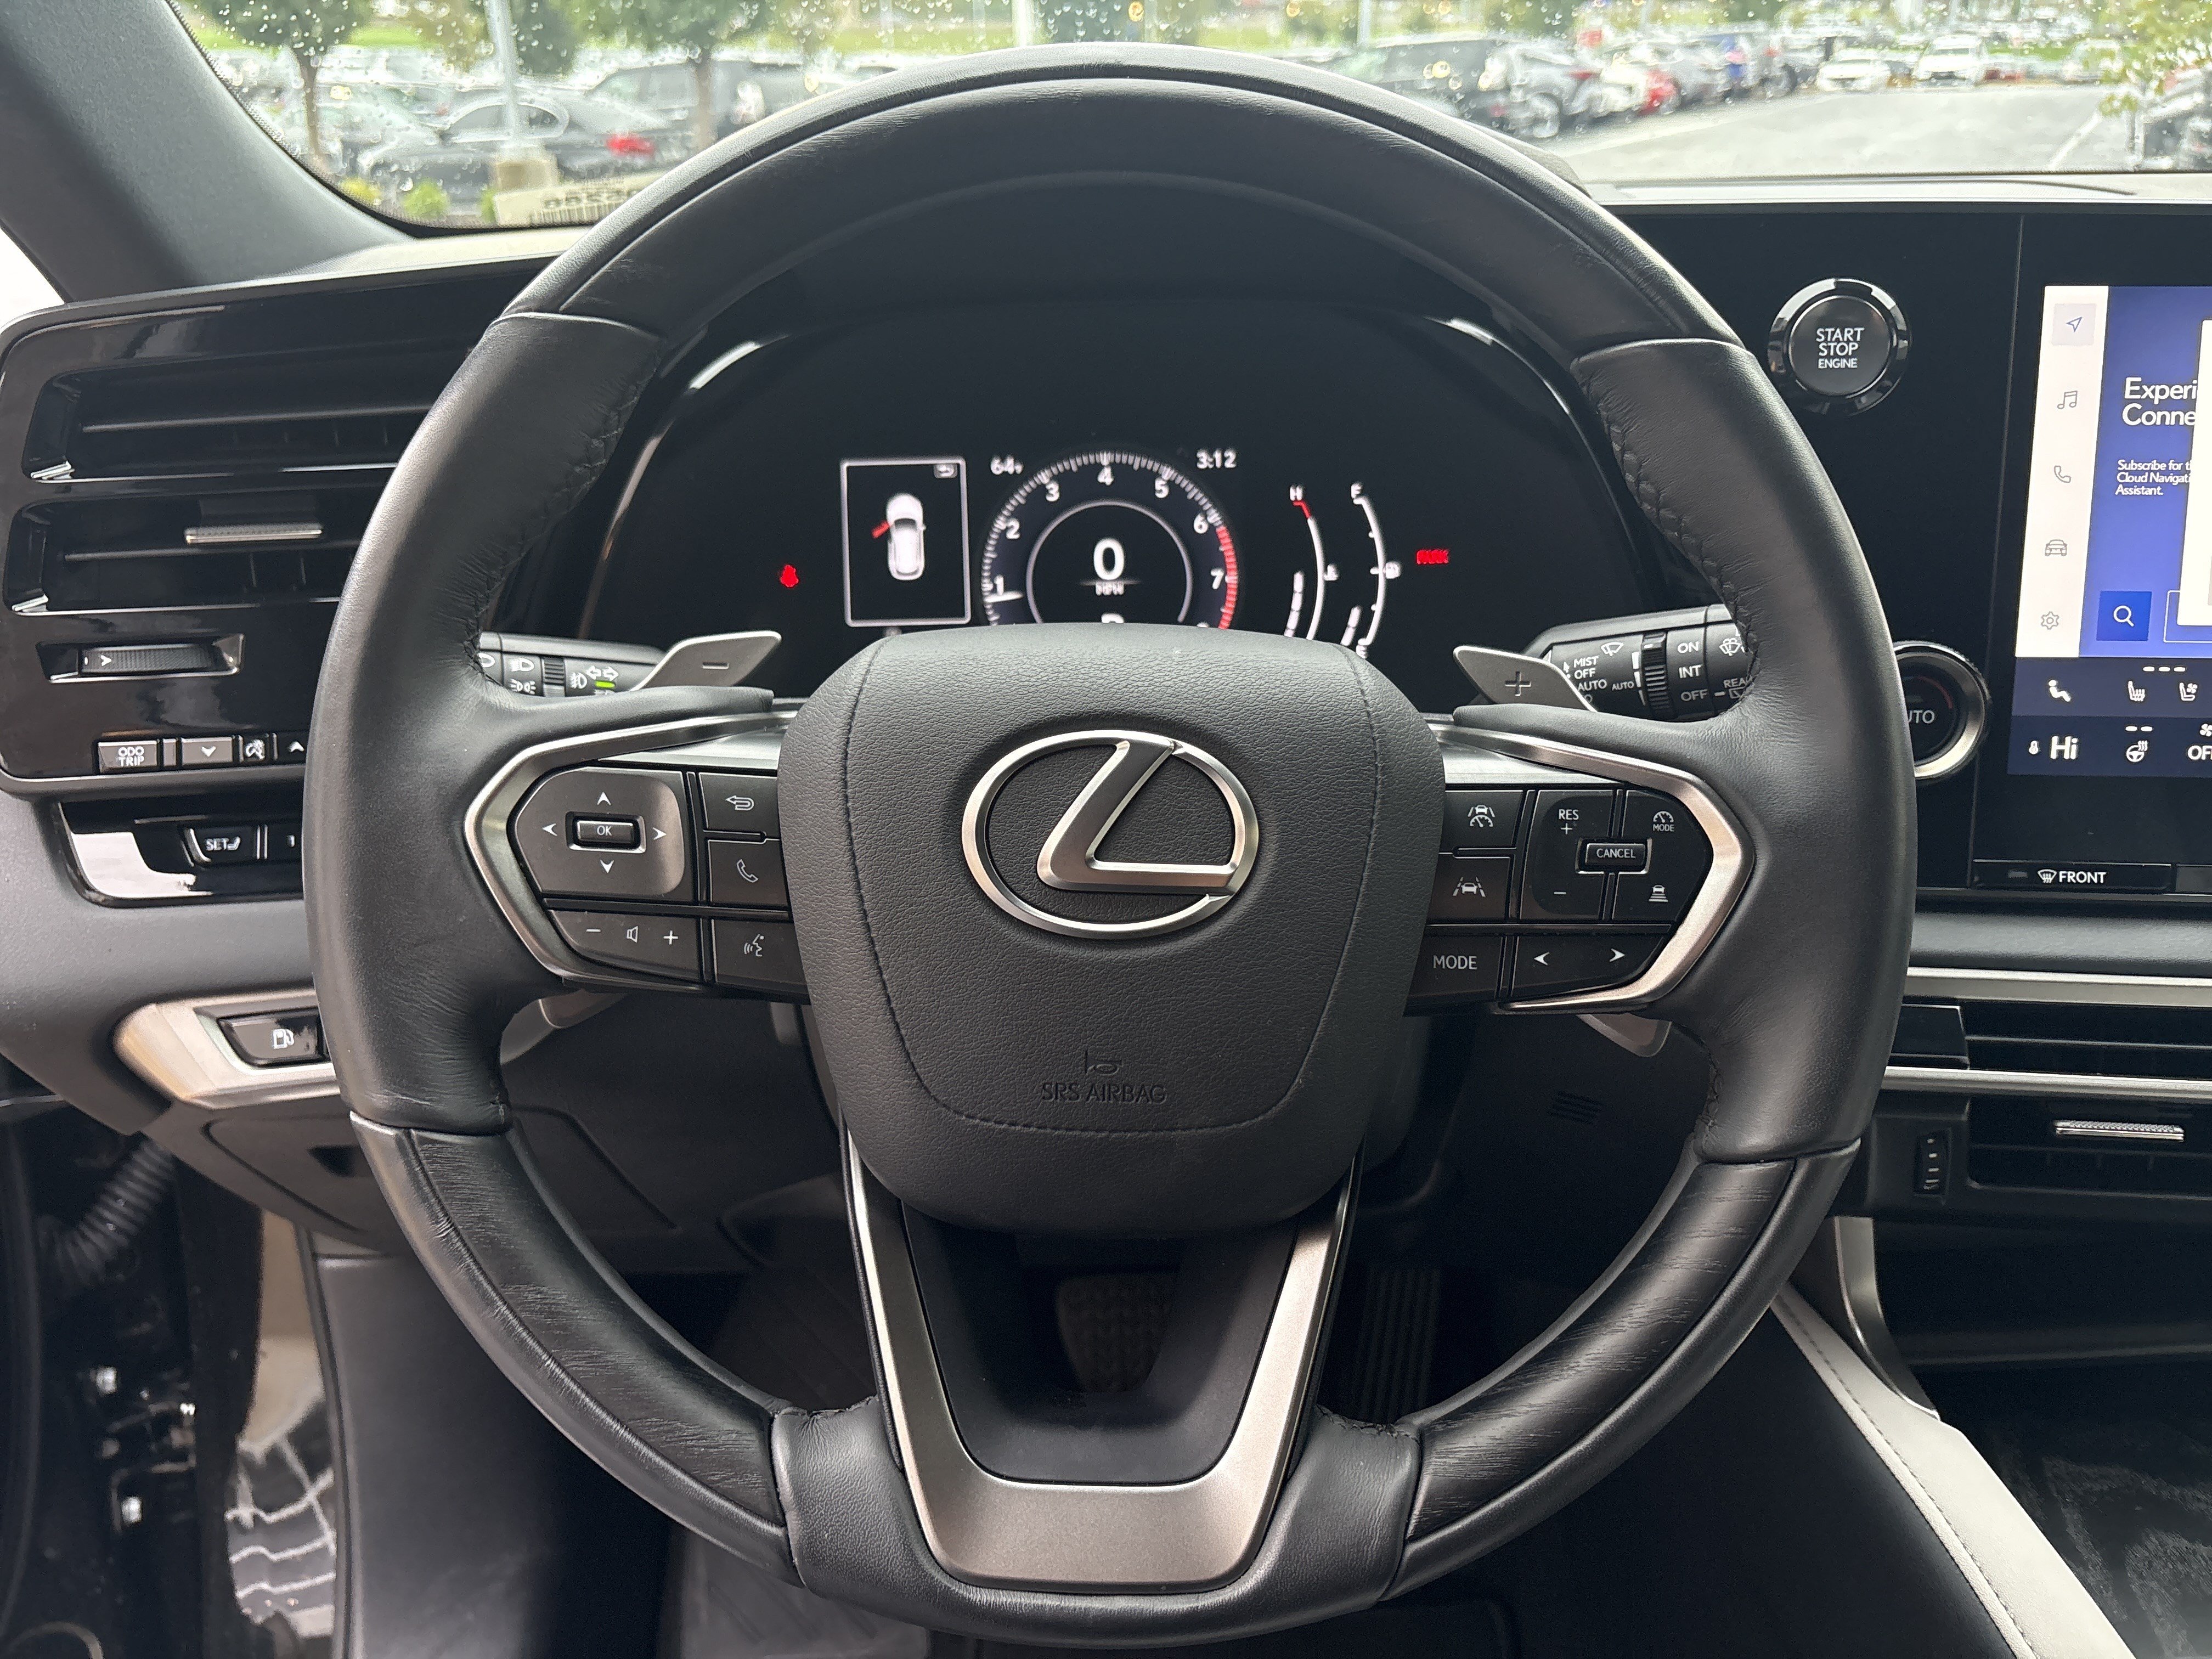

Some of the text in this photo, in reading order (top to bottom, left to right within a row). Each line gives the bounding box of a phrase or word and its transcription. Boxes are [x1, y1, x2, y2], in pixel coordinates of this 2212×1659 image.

[1816, 328, 1865, 342] START
[1819, 342, 1859, 356] STOP
[1818, 358, 1858, 369] ENGINE
[1197, 448, 1237, 469] 3:12
[2117, 460, 2167, 471] Subscribe
[2168, 460, 2183, 470] for
[1097, 466, 1114, 486] 4
[2116, 472, 2148, 483] Cloud
[1045, 480, 1060, 502] 3
[1154, 477, 1169, 498] 5
[2115, 484, 2164, 495] Assistant.
[1006, 518, 1020, 539] 2
[1194, 514, 1209, 534] 6
[1093, 538, 1125, 580] 0
[994, 575, 1005, 595] 1
[1210, 568, 1224, 590] 7
[1677, 642, 1699, 653] ON
[1573, 656, 1599, 668] MIST
[1574, 668, 1596, 680] OFF
[1679, 665, 1702, 679] INT
[1578, 679, 1607, 691] AUTO
[1611, 681, 1634, 691] AUTO
[1680, 690, 1708, 702] OFF
[118, 746, 144, 757] ODO
[2050, 736, 2079, 760] Hi
[119, 756, 144, 766] TRIP
[1559, 809, 1579, 820] RES
[596, 826, 612, 836] OK
[206, 838, 229, 850] SET
[1596, 848, 1636, 859] CANCEL
[2058, 871, 2107, 883] FRONT
[1433, 955, 1477, 970] MODE
[1042, 1082, 1168, 1105] SRS AIRBAG
